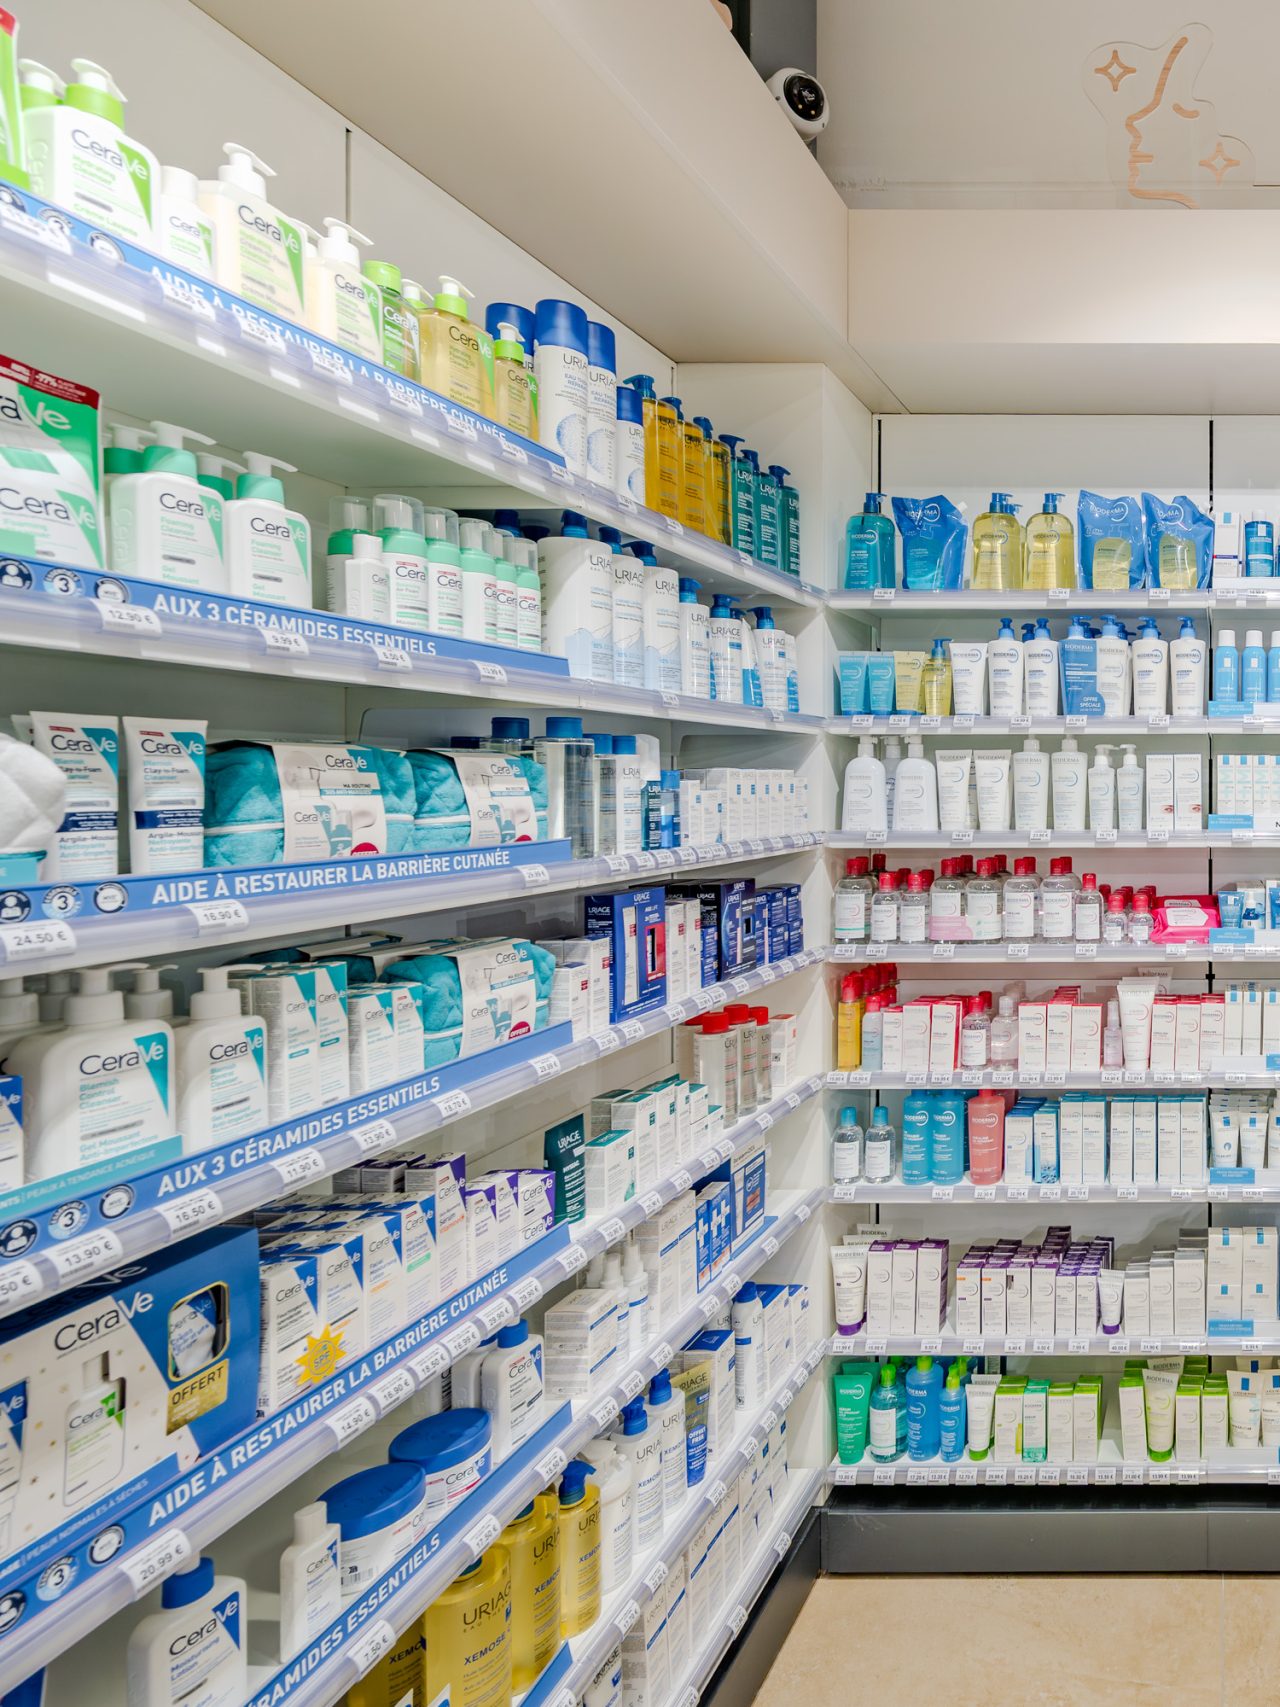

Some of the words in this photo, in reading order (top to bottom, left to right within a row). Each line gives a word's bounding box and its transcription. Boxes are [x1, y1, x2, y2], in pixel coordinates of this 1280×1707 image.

[71, 129, 148, 180] CeraVe
[238, 205, 300, 253] CeraVe
[334, 274, 379, 308] CeraVe
[449, 325, 493, 359] CeraVe
[507, 369, 538, 394] CeraVe
[160, 493, 222, 522] CeraVe
[250, 517, 306, 543] CeraVe
[153, 594, 202, 619] AUX
[208, 603, 221, 622] 3
[226, 604, 340, 642] CÉRAMIDES
[343, 627, 437, 657] ESSENTIELS
[51, 734, 118, 753] CeraVe
[141, 738, 204, 755] CeraVe
[325, 755, 368, 769] CeraVe
[490, 763, 521, 775] CeraVe
[152, 879, 209, 905] AIDE
[215, 873, 230, 896] À
[235, 867, 348, 895] RESTAURER
[352, 864, 372, 883] LA
[377, 855, 451, 880] BARRIÈRE
[453, 848, 510, 871] CUTANÉE
[203, 911, 232, 923] 16.90
[14, 931, 53, 947] 24.50
[495, 949, 528, 965] CeraVe
[510, 1025, 531, 1039] OFFERT
[79, 1042, 164, 1076] CeraVe
[209, 1035, 264, 1061] CeraVe
[158, 1164, 208, 1198] AUX
[212, 1156, 225, 1176] 3
[230, 1112, 343, 1170] CÉRAMIDES
[347, 1076, 441, 1126] ESSENTIELS
[439, 1178, 466, 1200] CeraVe
[523, 1177, 553, 1201] CeraVe
[64, 1211, 75, 1228] 3
[176, 1204, 206, 1224] 16.50
[405, 1209, 433, 1231] CeraVe
[369, 1230, 400, 1252] CeraVe
[523, 1216, 553, 1241] CeraVe
[64, 1246, 101, 1267] 13.90
[327, 1252, 360, 1277] CeraVe
[276, 1276, 315, 1302] CeraVe
[54, 1291, 154, 1352] CeraVe
[509, 1352, 542, 1379] CeraVe
[149, 1470, 207, 1528] AIDE
[211, 1456, 227, 1484] À
[232, 1381, 346, 1470] RESTAURER
[349, 1363, 372, 1386] LA
[374, 1311, 449, 1364] BARRIÈRE
[451, 1268, 509, 1316] CUTANÉE
[172, 1366, 224, 1406] OFFERT
[341, 1415, 363, 1434] 14.90
[688, 1426, 706, 1439] OFFERT
[446, 1456, 486, 1485] CeraVe
[140, 1552, 173, 1580] 20.99
[169, 1600, 239, 1656] CeraVe
[250, 1629, 344, 1707] RAMIDES
[346, 1534, 441, 1635] ESSENTIELS
[464, 1633, 506, 1666] XEMOSE
